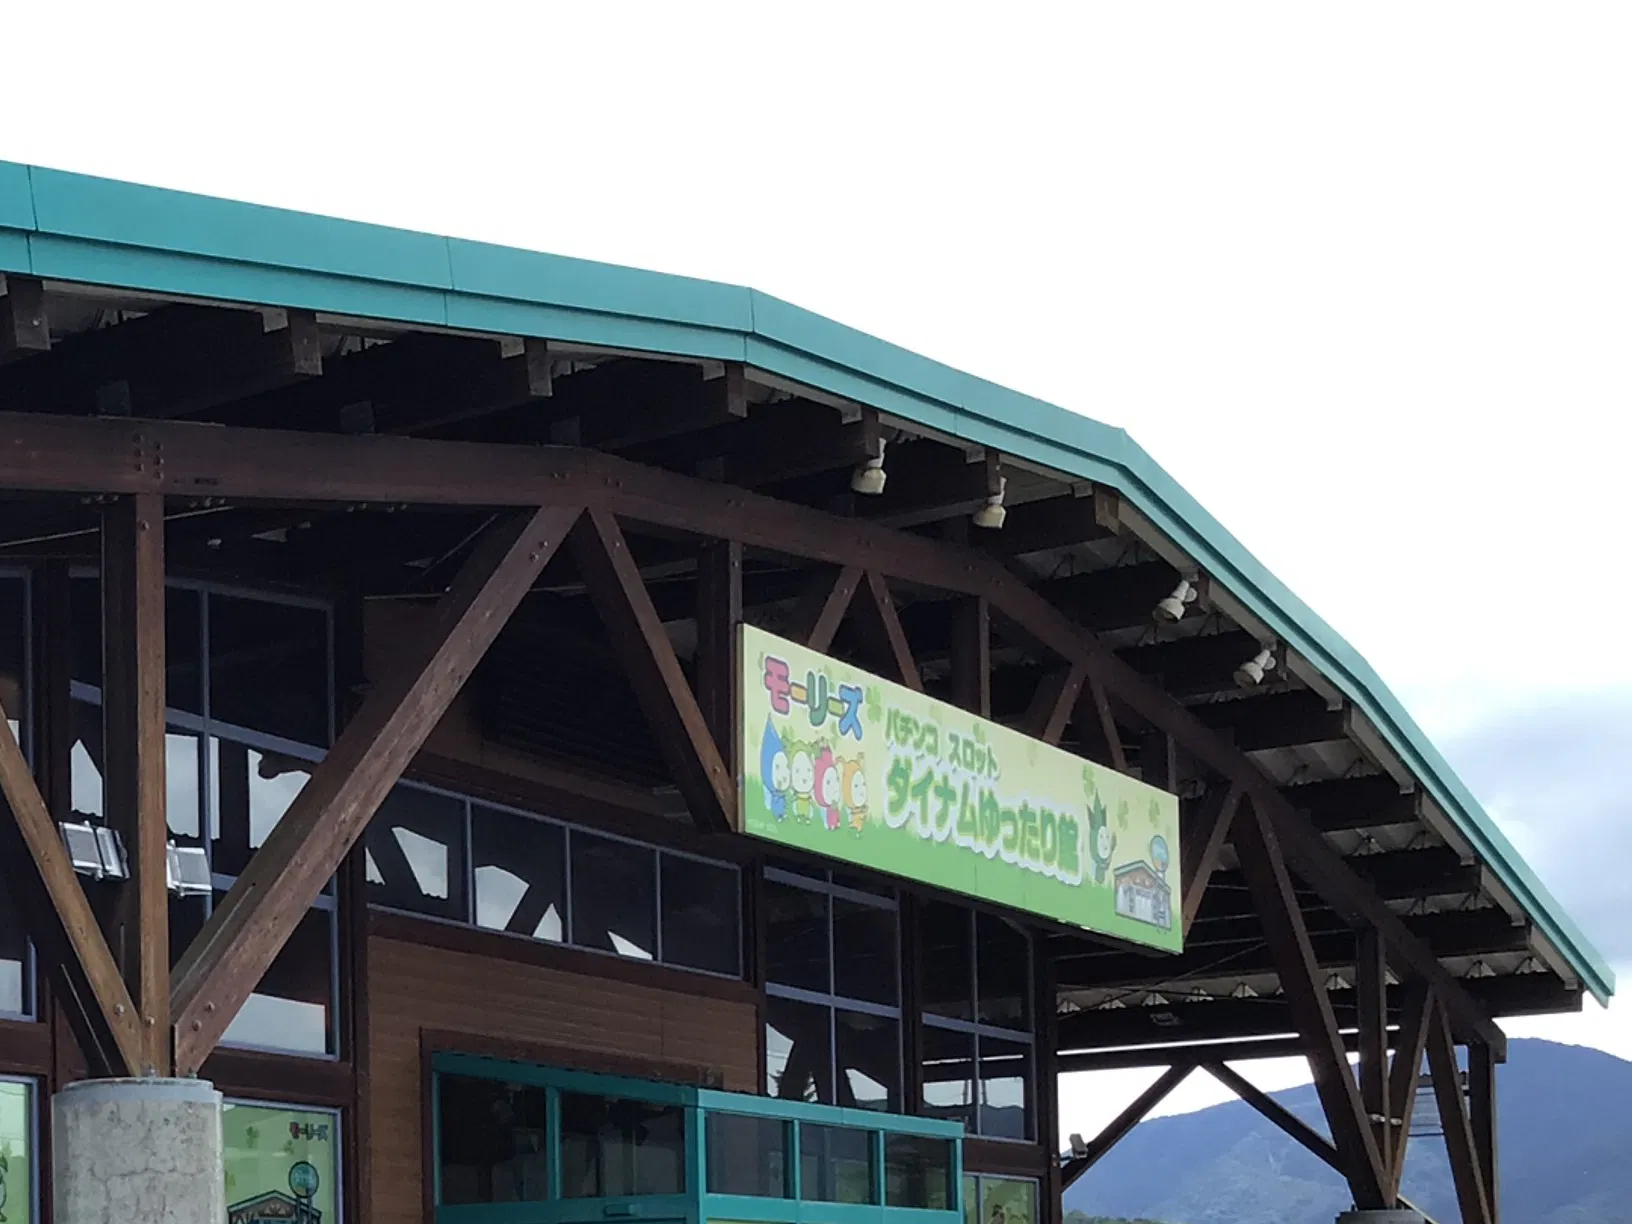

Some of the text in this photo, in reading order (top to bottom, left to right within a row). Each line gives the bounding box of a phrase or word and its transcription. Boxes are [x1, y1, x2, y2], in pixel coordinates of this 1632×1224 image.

[764, 655, 864, 741] モーリーズ
[885, 706, 1000, 780] パチンコ スロット
